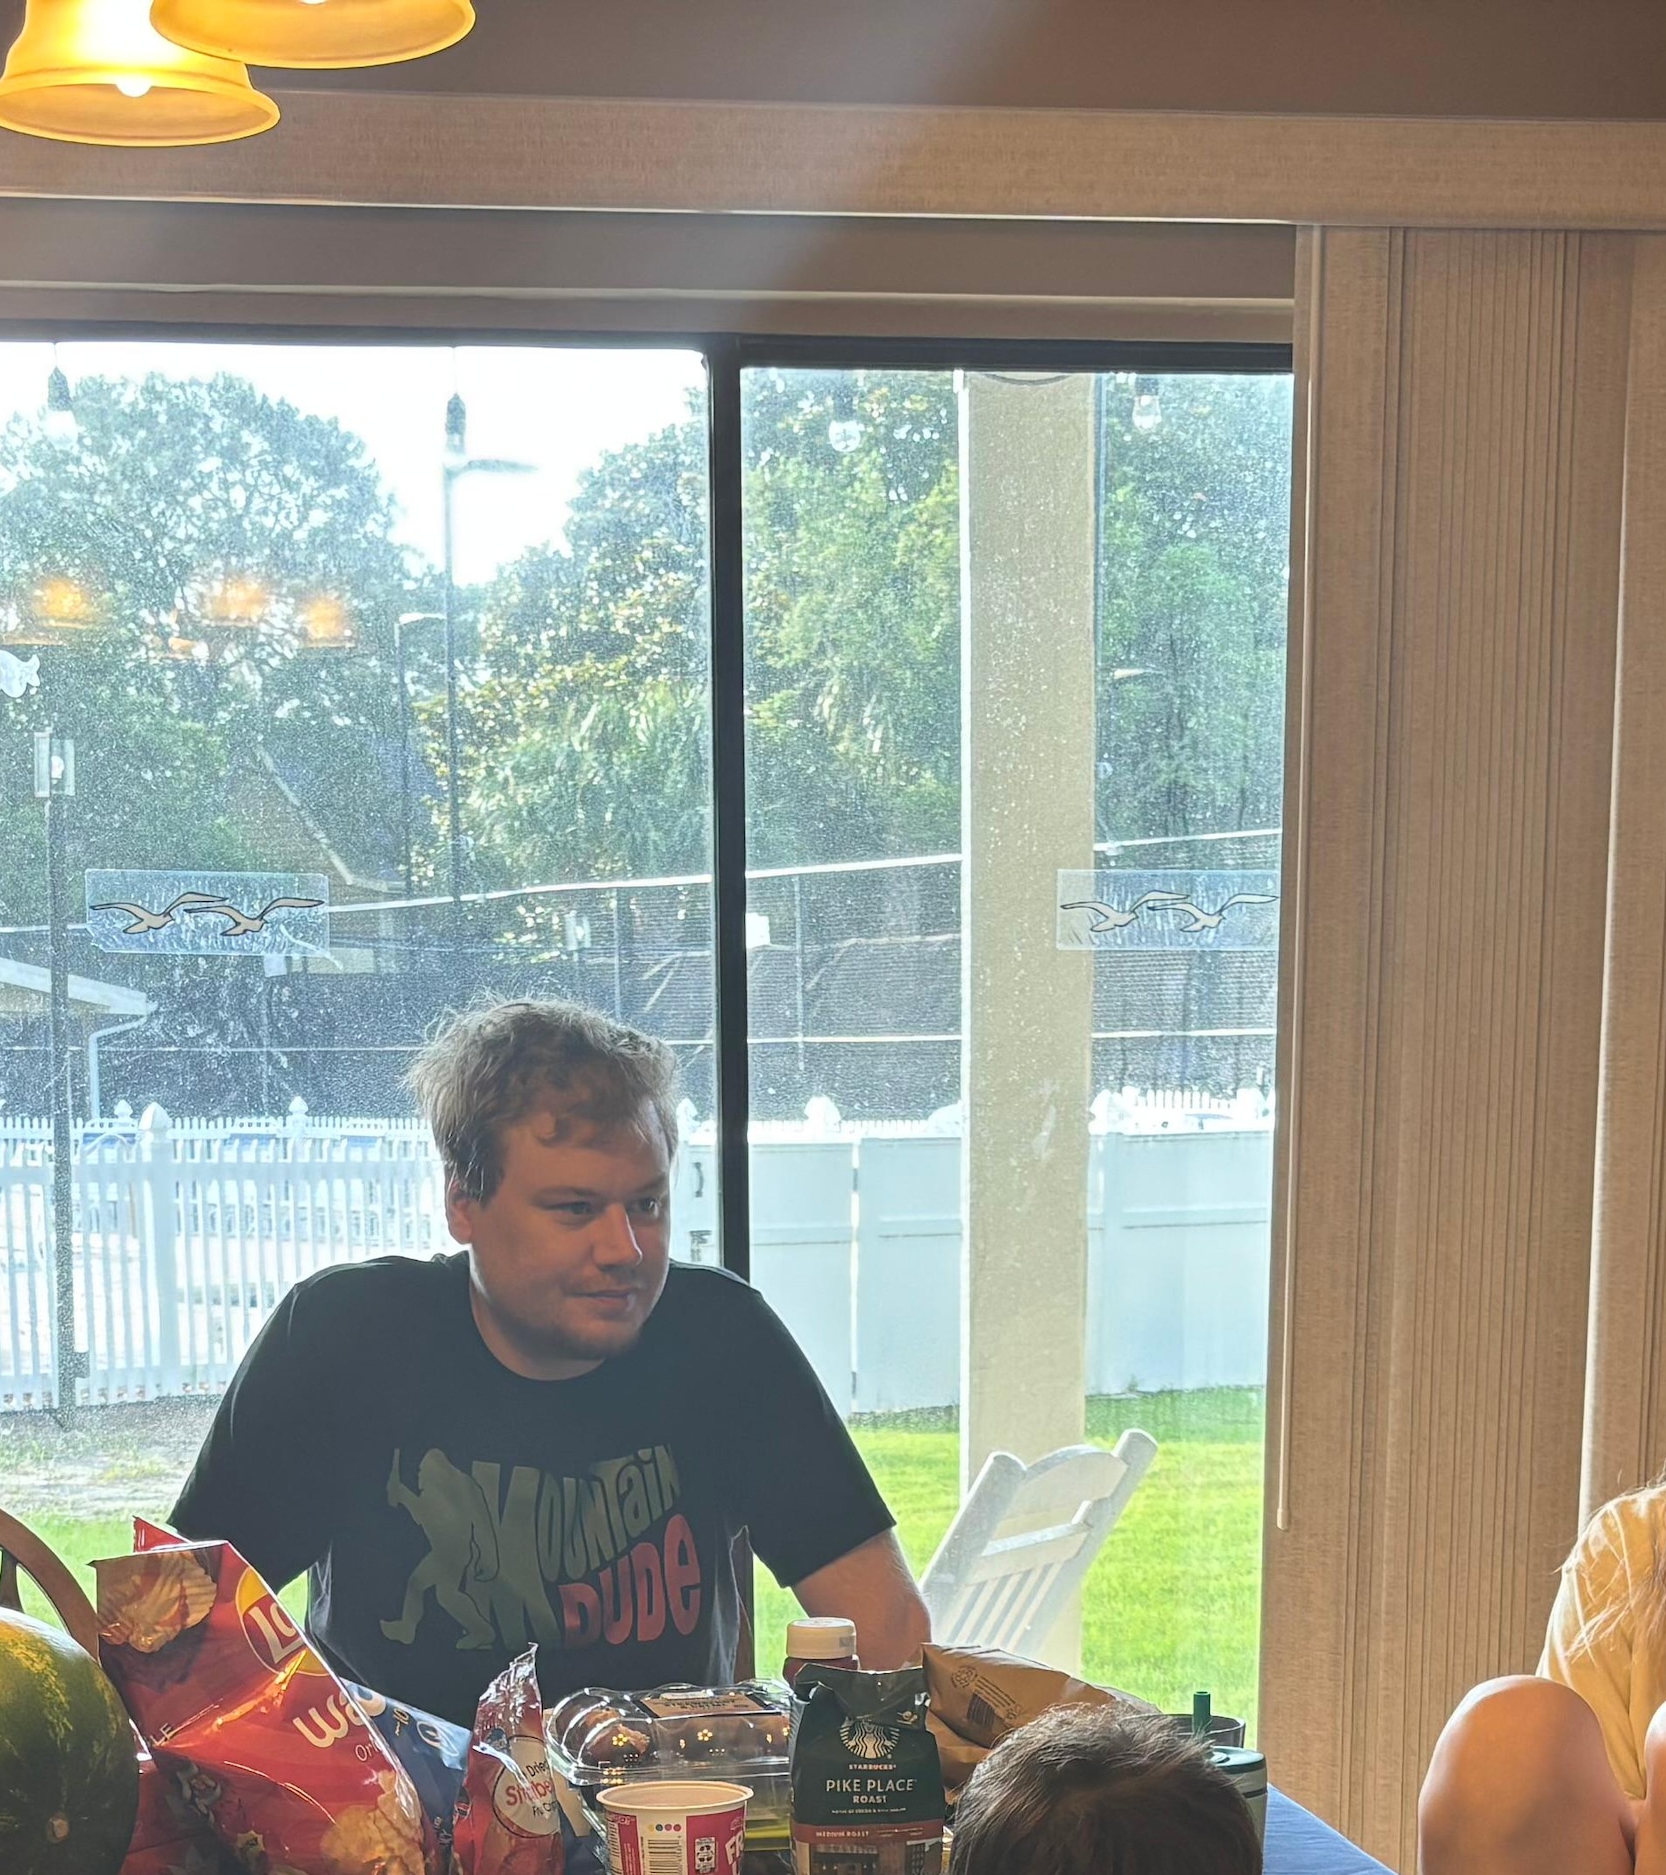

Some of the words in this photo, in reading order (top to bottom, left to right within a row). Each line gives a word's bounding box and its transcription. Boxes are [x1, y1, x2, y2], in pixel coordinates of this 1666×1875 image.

[826, 1779, 861, 1792] PIKE
[867, 1779, 913, 1792] PLACE
[853, 1795, 887, 1804] ROAST
